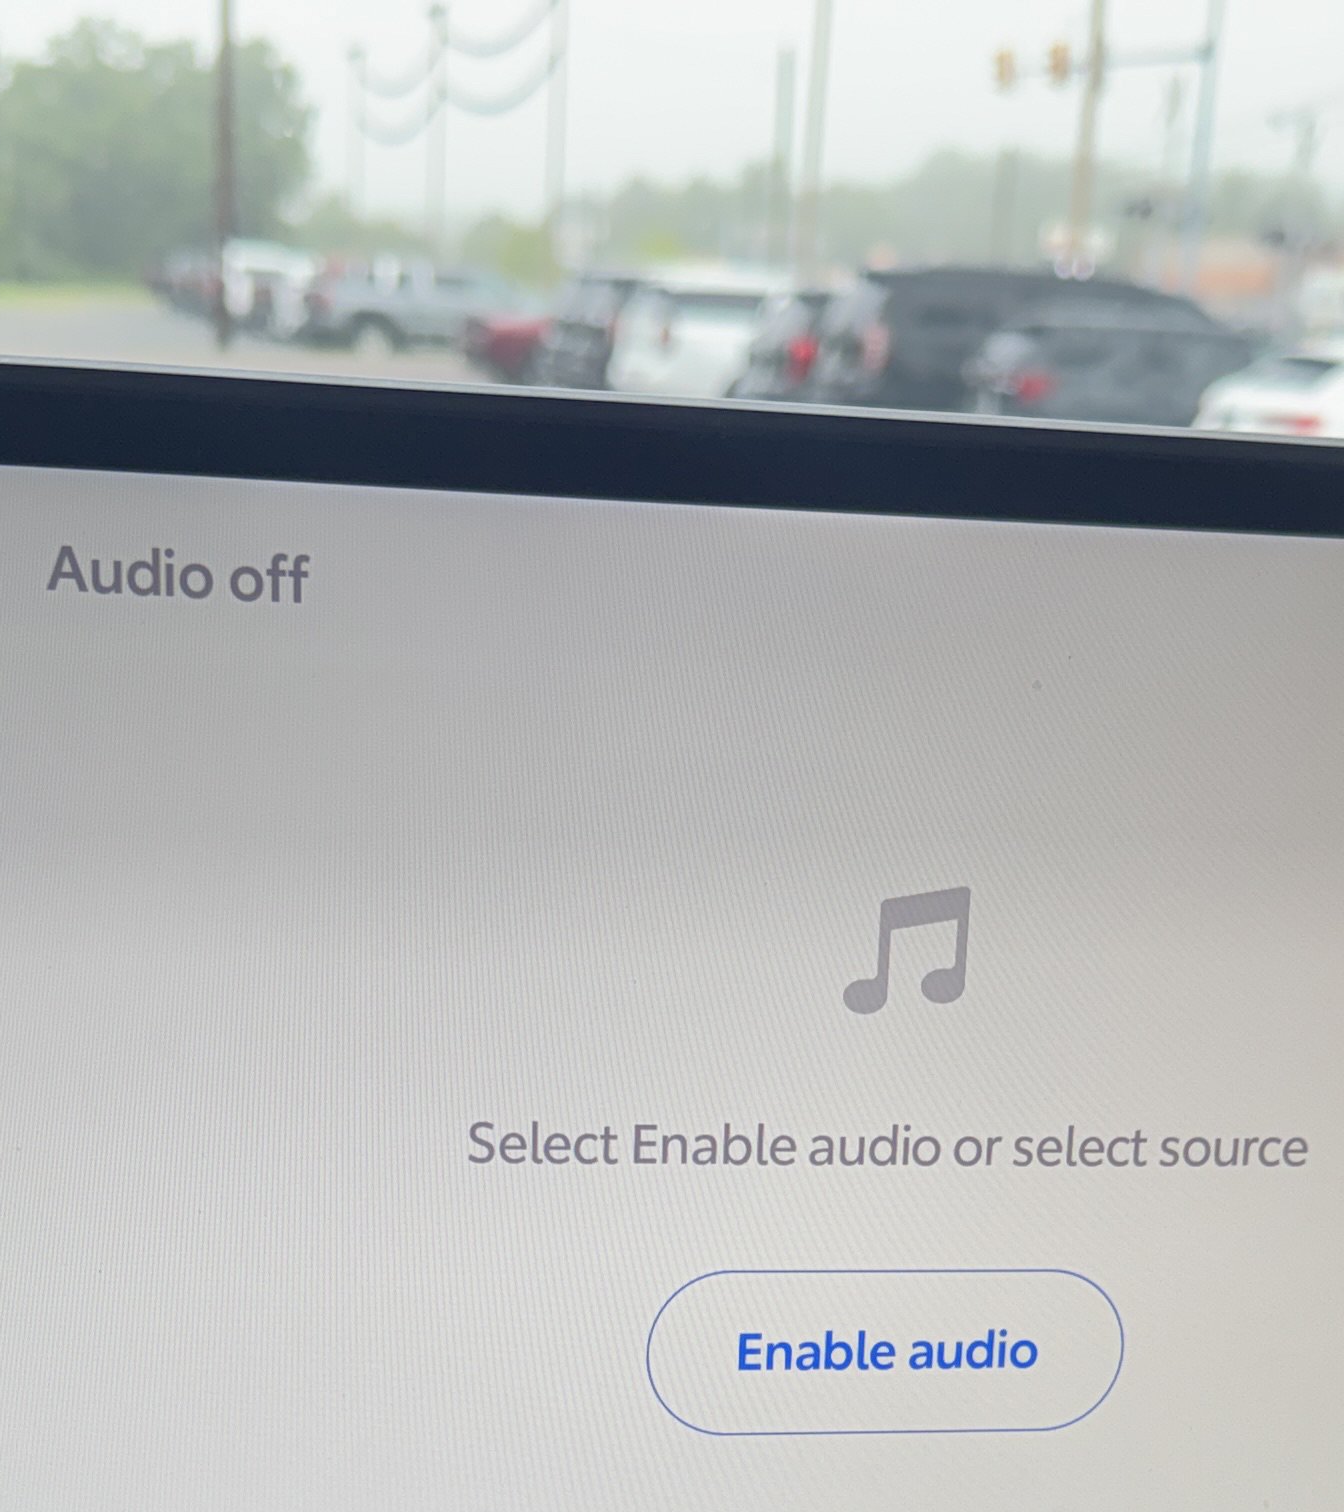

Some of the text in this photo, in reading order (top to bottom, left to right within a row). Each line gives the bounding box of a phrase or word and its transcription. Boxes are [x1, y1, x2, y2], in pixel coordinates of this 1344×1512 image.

[47, 544, 311, 604] Audio off
[468, 1121, 1309, 1169] Select Enable audio or select source
[737, 1330, 1039, 1373] Enable audio
